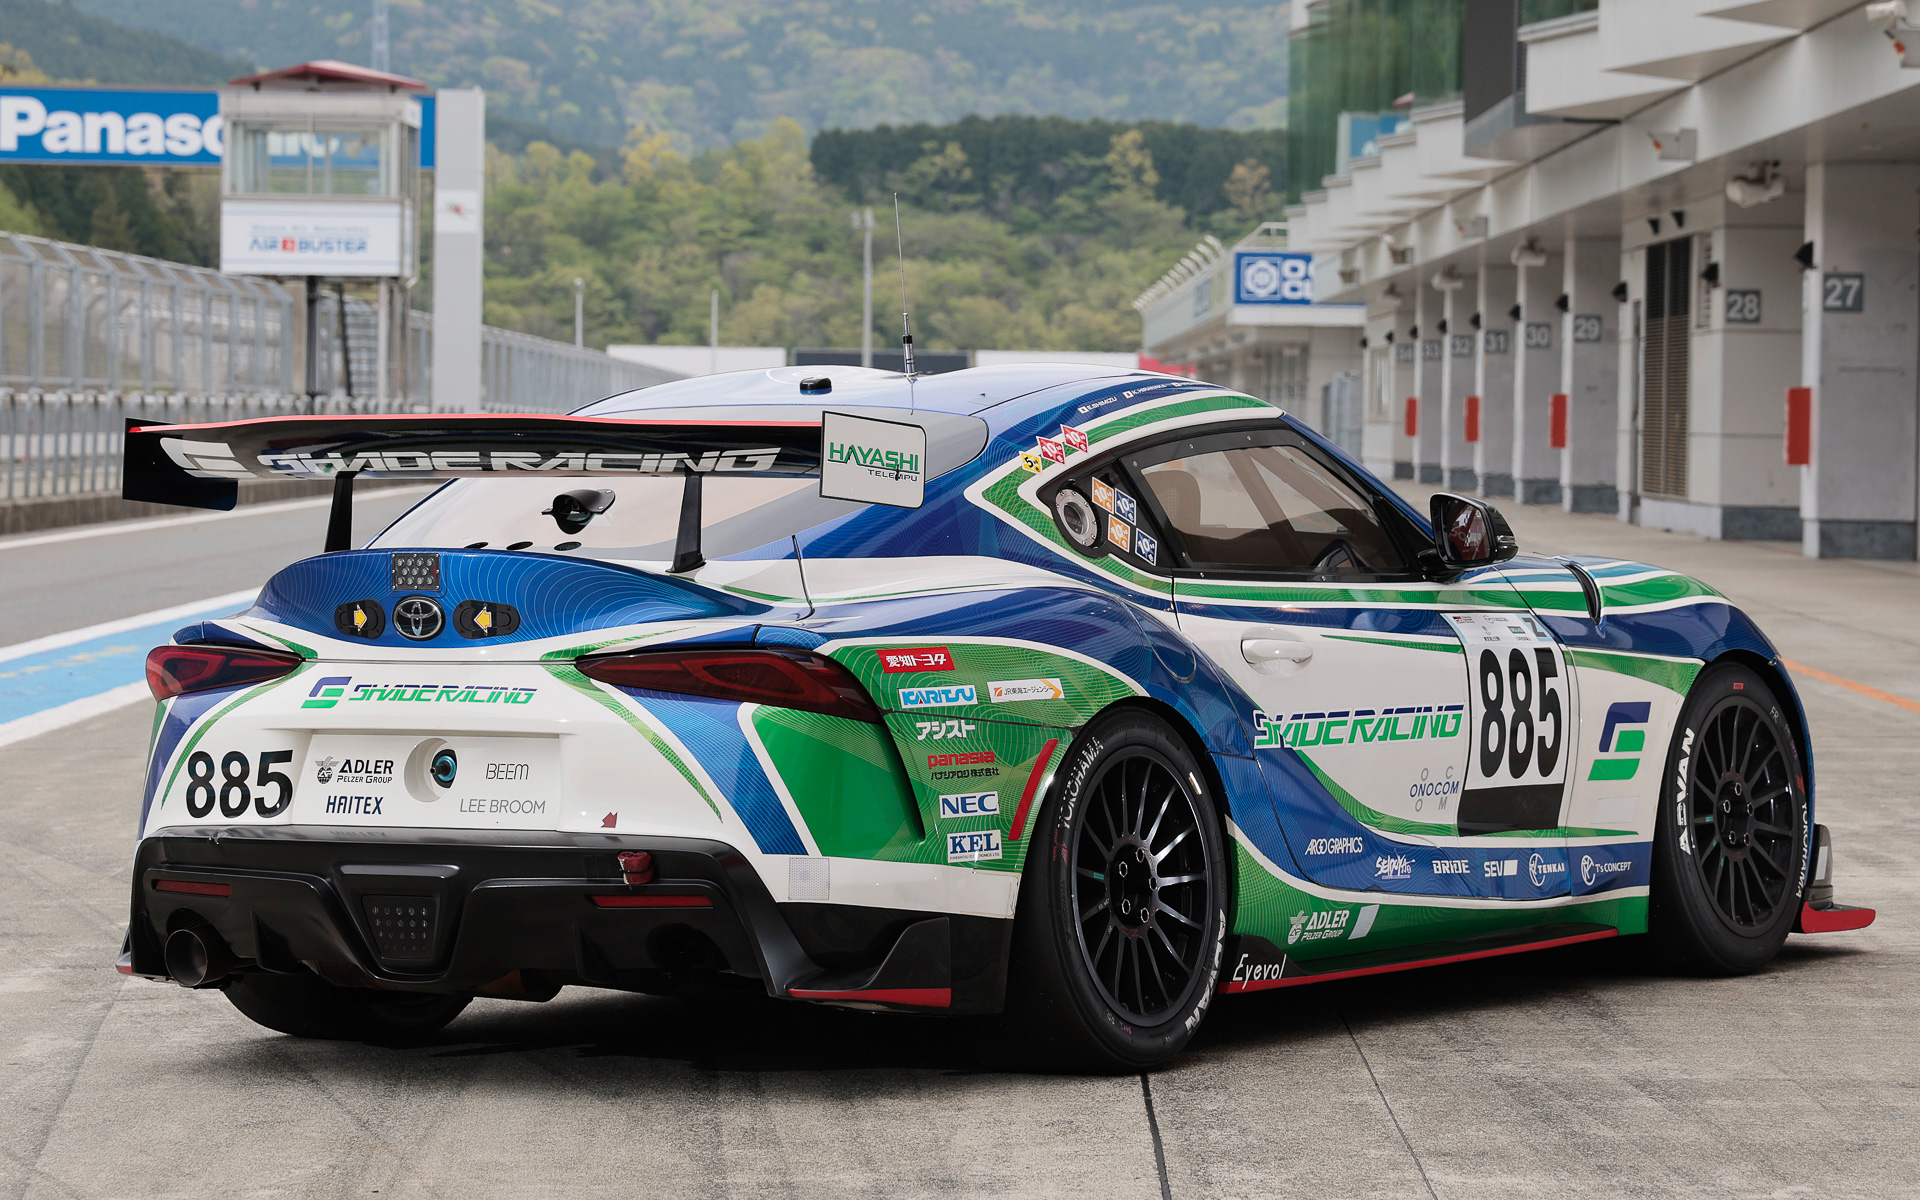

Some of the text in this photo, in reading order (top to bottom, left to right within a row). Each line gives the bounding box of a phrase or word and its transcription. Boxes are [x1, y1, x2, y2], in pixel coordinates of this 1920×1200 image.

[298, 237, 368, 253] BUSTER
[1824, 278, 1862, 307] 27
[1727, 294, 1759, 320] 28
[1526, 325, 1550, 347] 30
[1575, 317, 1600, 340] 29
[1486, 333, 1506, 352] 31
[490, 446, 782, 472] RACING
[829, 442, 919, 472] HAYASHI
[1024, 456, 1034, 468] 5
[1094, 486, 1108, 503] 10
[1116, 497, 1130, 514] 10
[1110, 524, 1124, 541] 10
[1137, 538, 1150, 555] 10
[885, 653, 947, 668] 愛知トヨタ
[349, 684, 538, 705] SHADE RACING
[902, 686, 975, 706] KARITSU
[1479, 647, 1562, 779] 885
[915, 719, 976, 741] アシスト
[1254, 704, 1465, 747] SHADE RACING
[338, 758, 394, 775] ADLER
[927, 750, 996, 770] panasia
[336, 775, 393, 784] PELZER GROUP
[485, 763, 530, 781] BEEM
[186, 749, 294, 819] 885
[1057, 736, 1104, 829] YOKOHAMA
[1409, 780, 1460, 798] ONOCOM
[1676, 727, 1696, 856] ADVAN
[325, 795, 384, 815] HAITEX
[459, 799, 546, 815] LEE BROOM
[941, 793, 998, 815] NEC
[949, 833, 1000, 854] KEL
[1795, 801, 1809, 898] YOKOHAMA
[1431, 859, 1471, 874] BRIDE
[1483, 860, 1503, 878] SEV
[1537, 862, 1565, 874] TENKAI
[1603, 861, 1632, 872] CONCEPT
[1305, 909, 1350, 931] ADLER
[1300, 928, 1344, 942] PELZER GROUP
[1232, 953, 1287, 990] Eyevol
